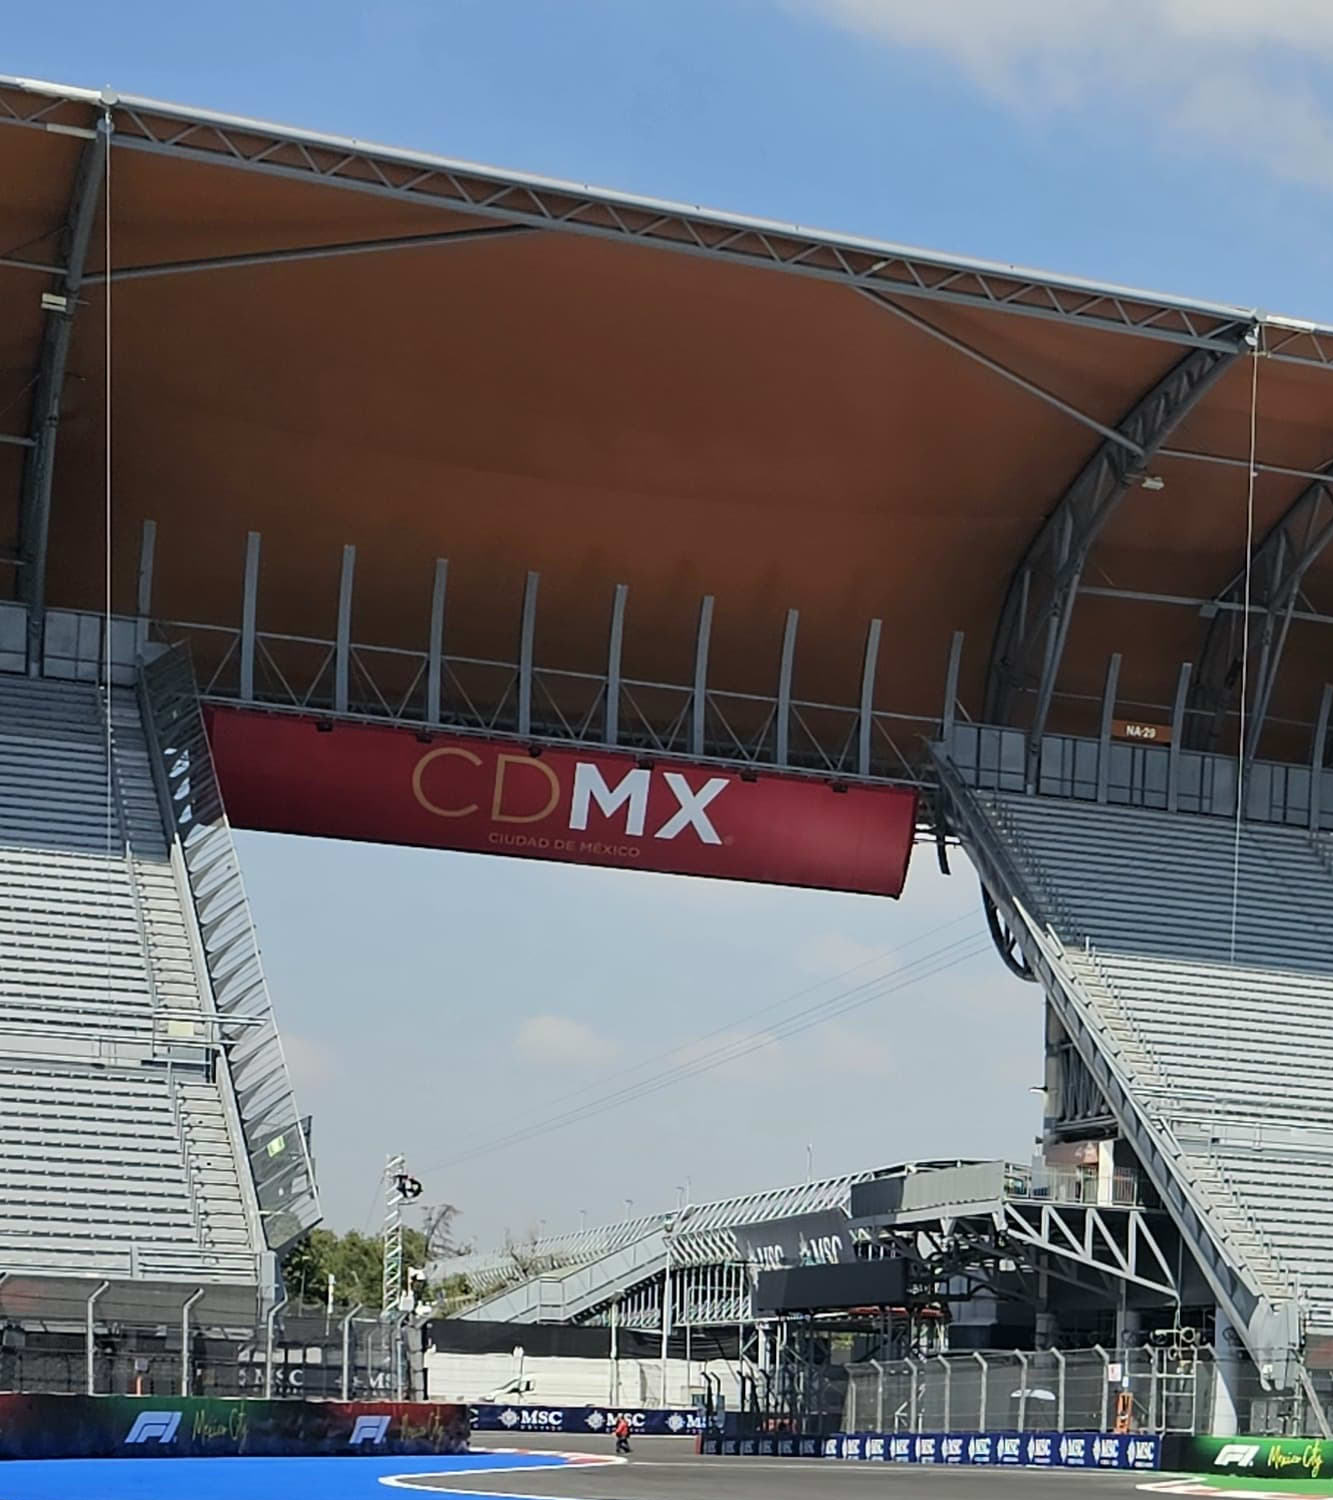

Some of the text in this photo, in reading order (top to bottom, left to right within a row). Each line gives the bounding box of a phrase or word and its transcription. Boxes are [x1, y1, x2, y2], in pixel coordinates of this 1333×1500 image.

[412, 746, 730, 845] CDMX
[488, 832, 641, 858] CIUDAD DE MÉXICO
[126, 1410, 183, 1444] F1
[350, 1415, 392, 1443] F1
[520, 1411, 564, 1425] MSC
[1214, 1438, 1324, 1478] F1 Mexico City
